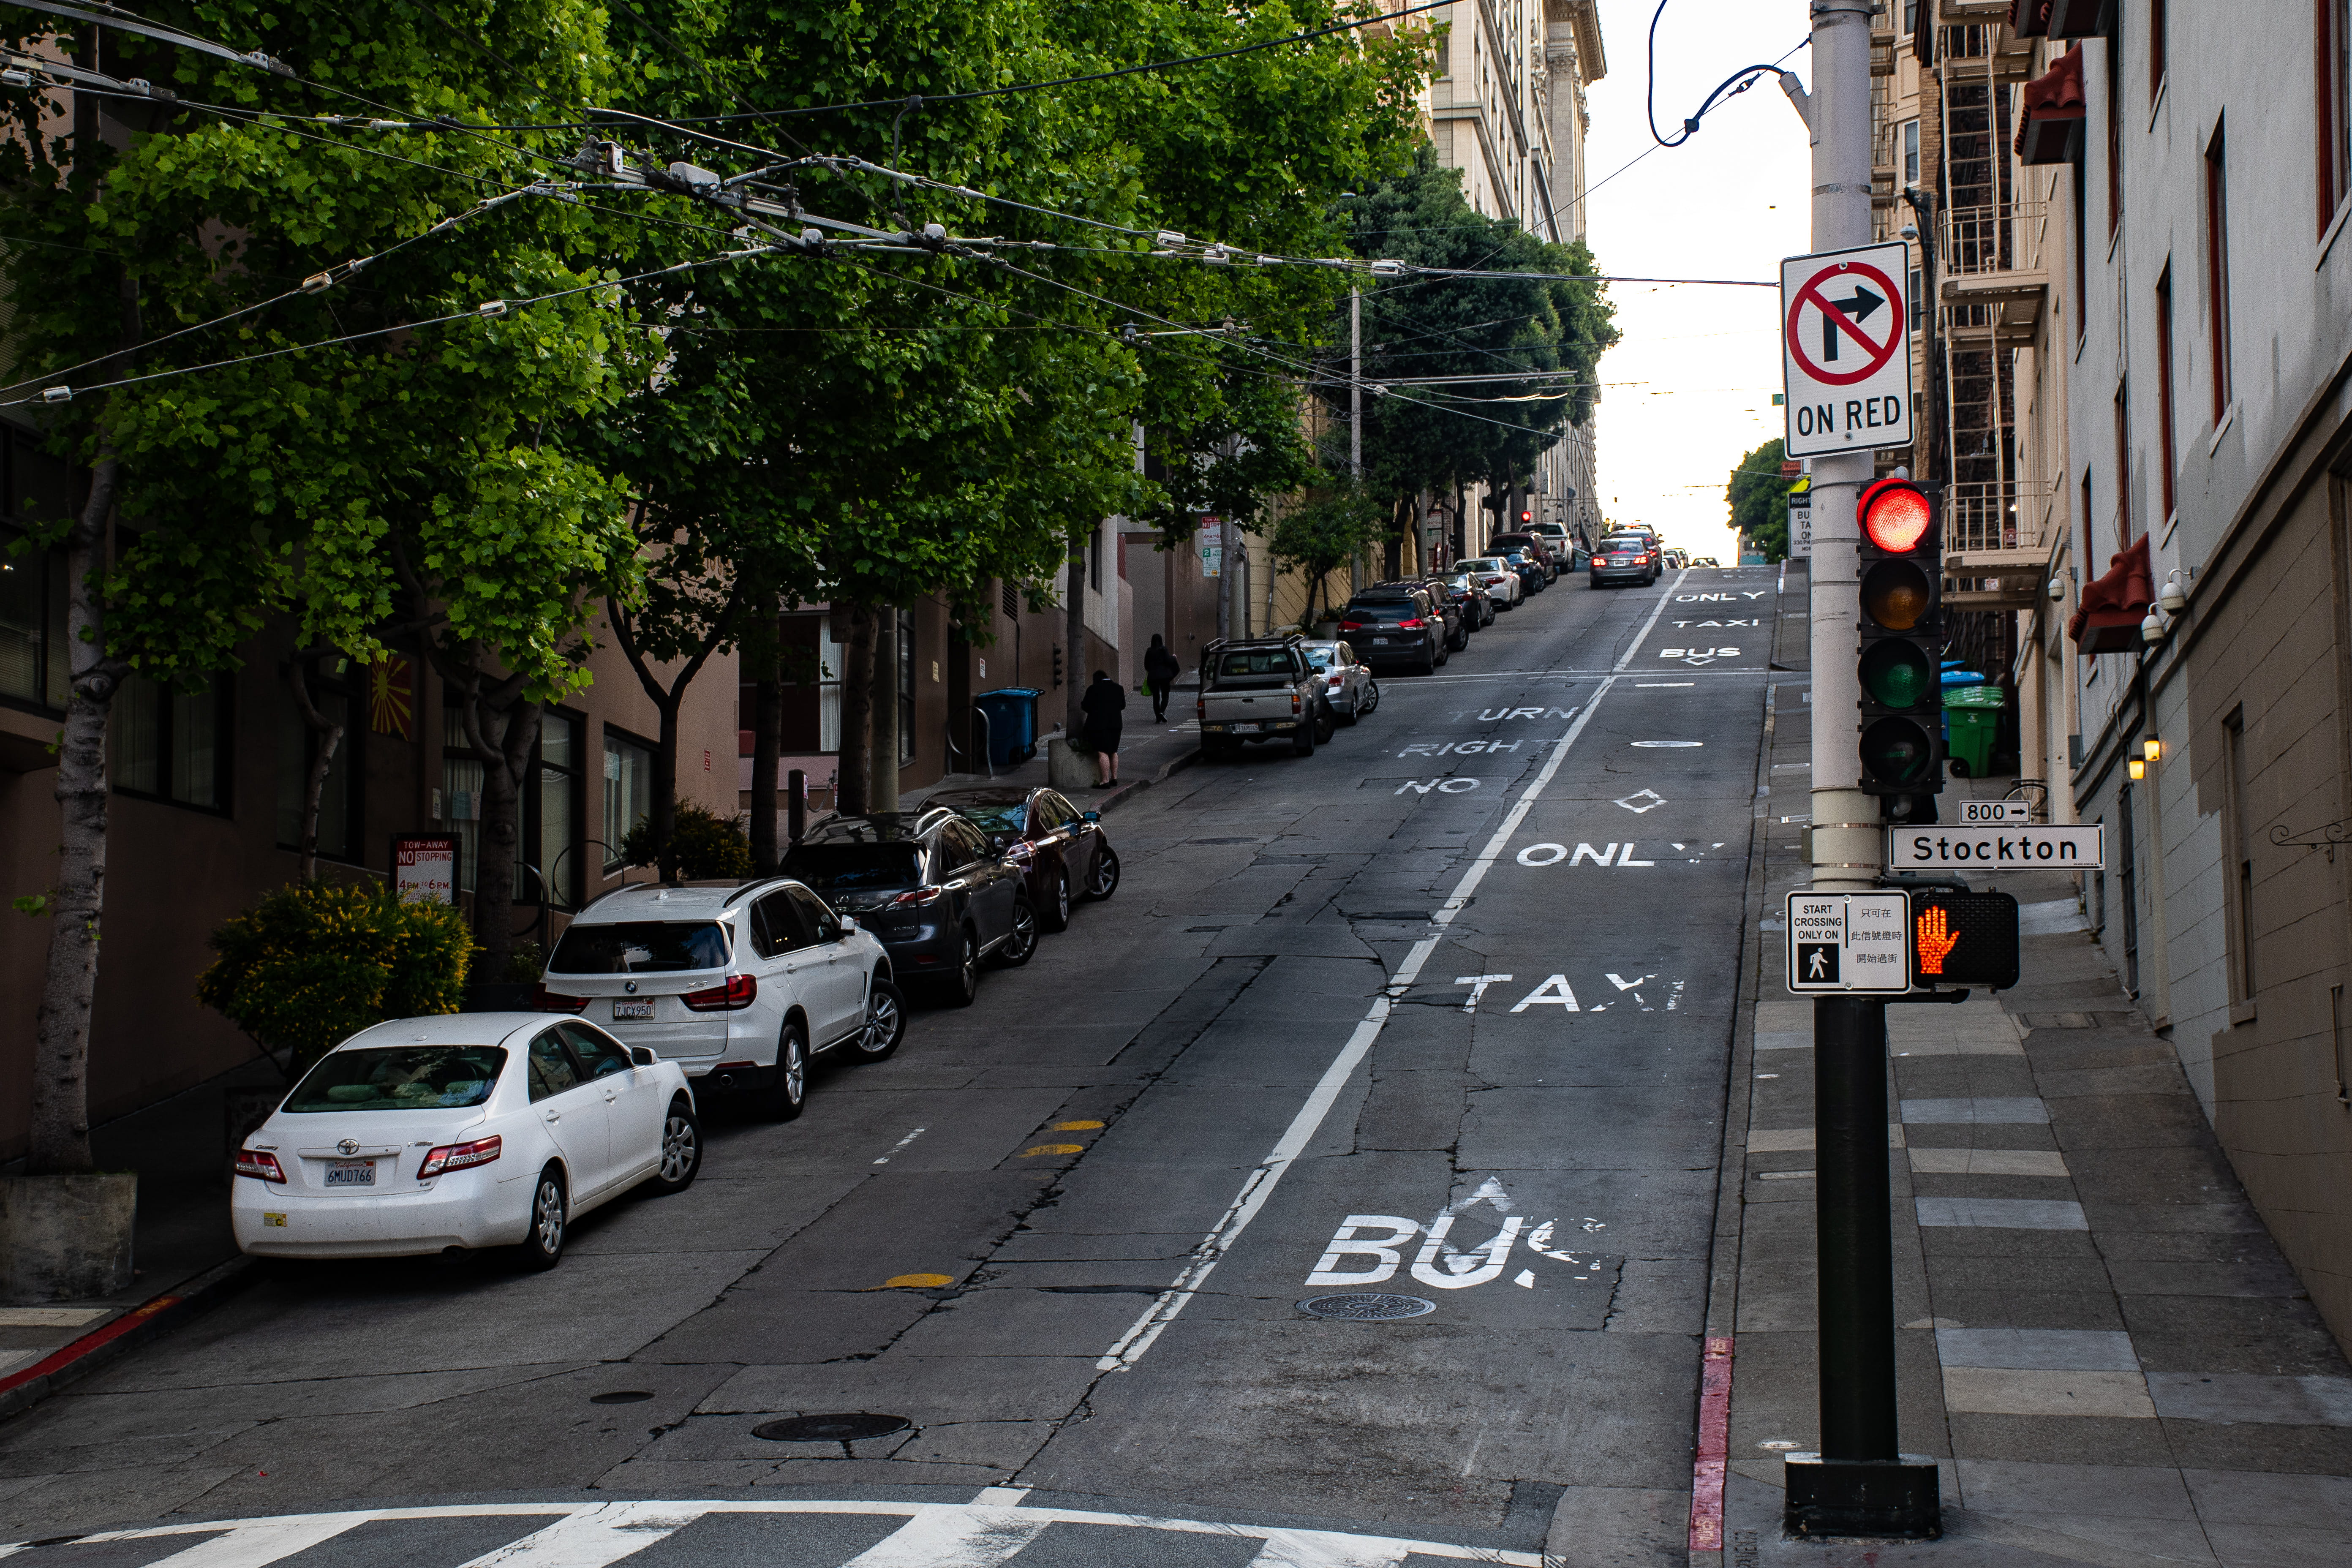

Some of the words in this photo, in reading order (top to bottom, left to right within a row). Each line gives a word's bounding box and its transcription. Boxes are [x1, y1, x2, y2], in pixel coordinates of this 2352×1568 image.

[1797, 406, 1834, 437] ON
[1846, 395, 1900, 430] RED
[1797, 511, 1810, 519] BU
[1800, 521, 1811, 529] TA
[1801, 531, 1811, 539] ON
[1675, 591, 1766, 602] ONLY
[1672, 619, 1759, 628] TAXI
[1659, 647, 1741, 658] BUS
[1448, 706, 1579, 723] TURN
[1397, 739, 1563, 758] RIGHT
[1394, 778, 1481, 795] NO
[1967, 804, 2004, 820] 800
[404, 841, 448, 849] TOW-AWAY
[1913, 836, 2077, 860] Stockton
[398, 851, 414, 864] NO
[417, 852, 452, 862] STOPPING
[1803, 905, 1832, 914] START
[1860, 908, 1892, 918] 只可在
[1794, 917, 1842, 927] CROSSING
[1798, 930, 1822, 939] ONLY
[1824, 930, 1838, 939] ON
[1851, 931, 1902, 941] 此信號燈時
[1856, 953, 1897, 964] 開始過街
[686, 980, 708, 989] X5
[616, 1005, 651, 1016] 7JCX950
[336, 1161, 364, 1169] California
[328, 1169, 372, 1182] 6MUD766
